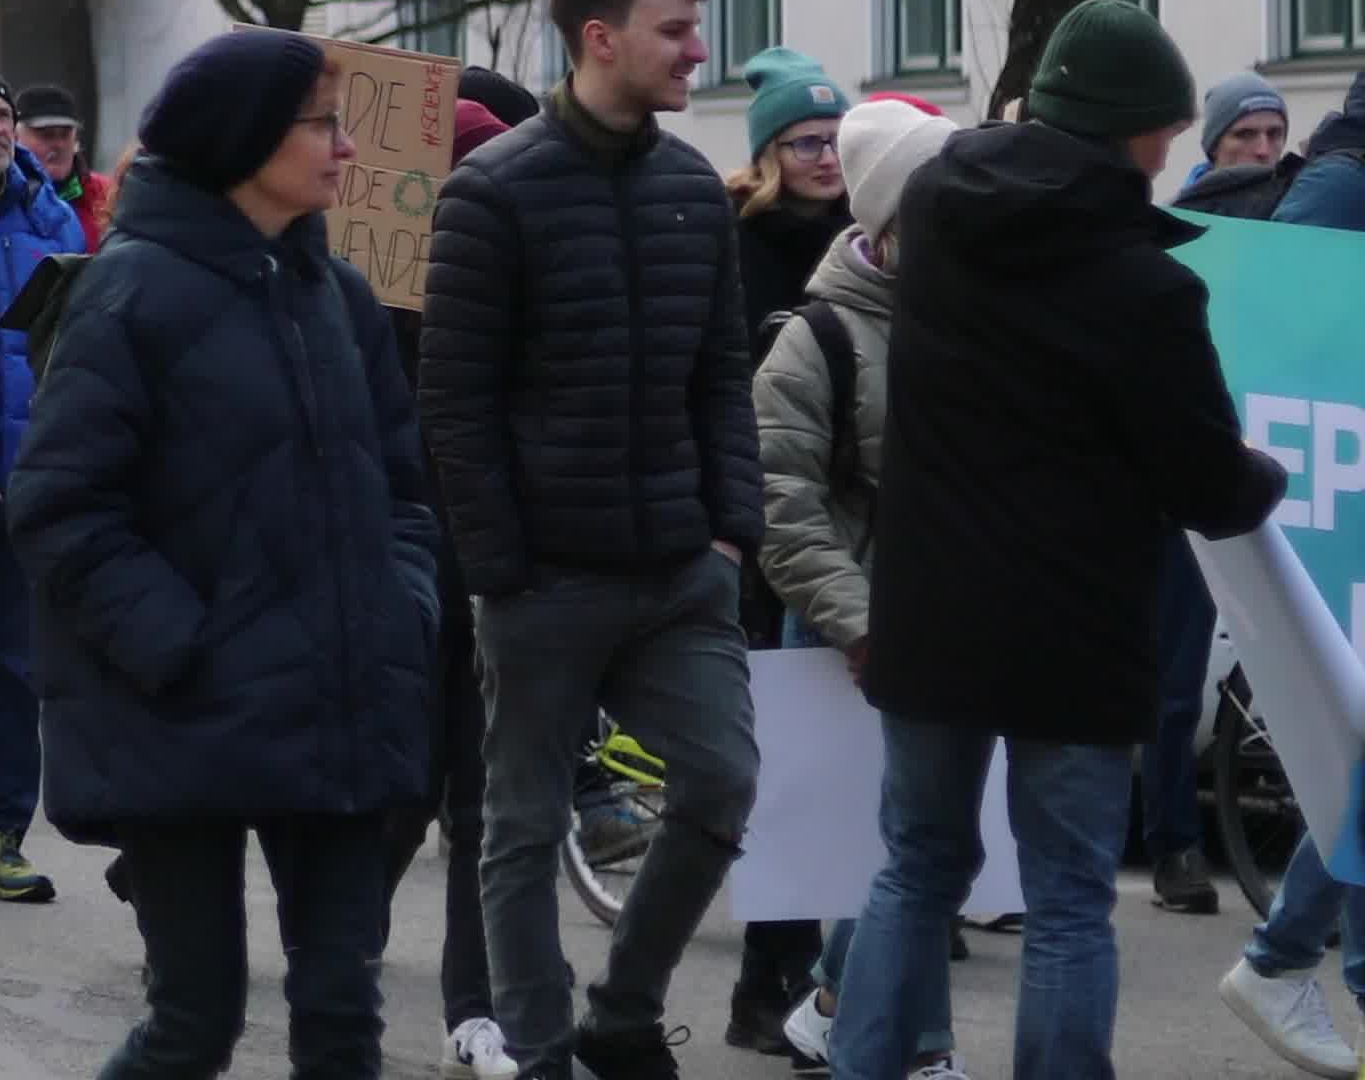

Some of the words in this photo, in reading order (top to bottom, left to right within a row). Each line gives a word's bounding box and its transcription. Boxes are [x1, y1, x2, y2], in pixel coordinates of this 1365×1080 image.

[344, 70, 406, 153] DIE
[333, 163, 385, 212] NDE
[341, 218, 433, 297] ENDE
